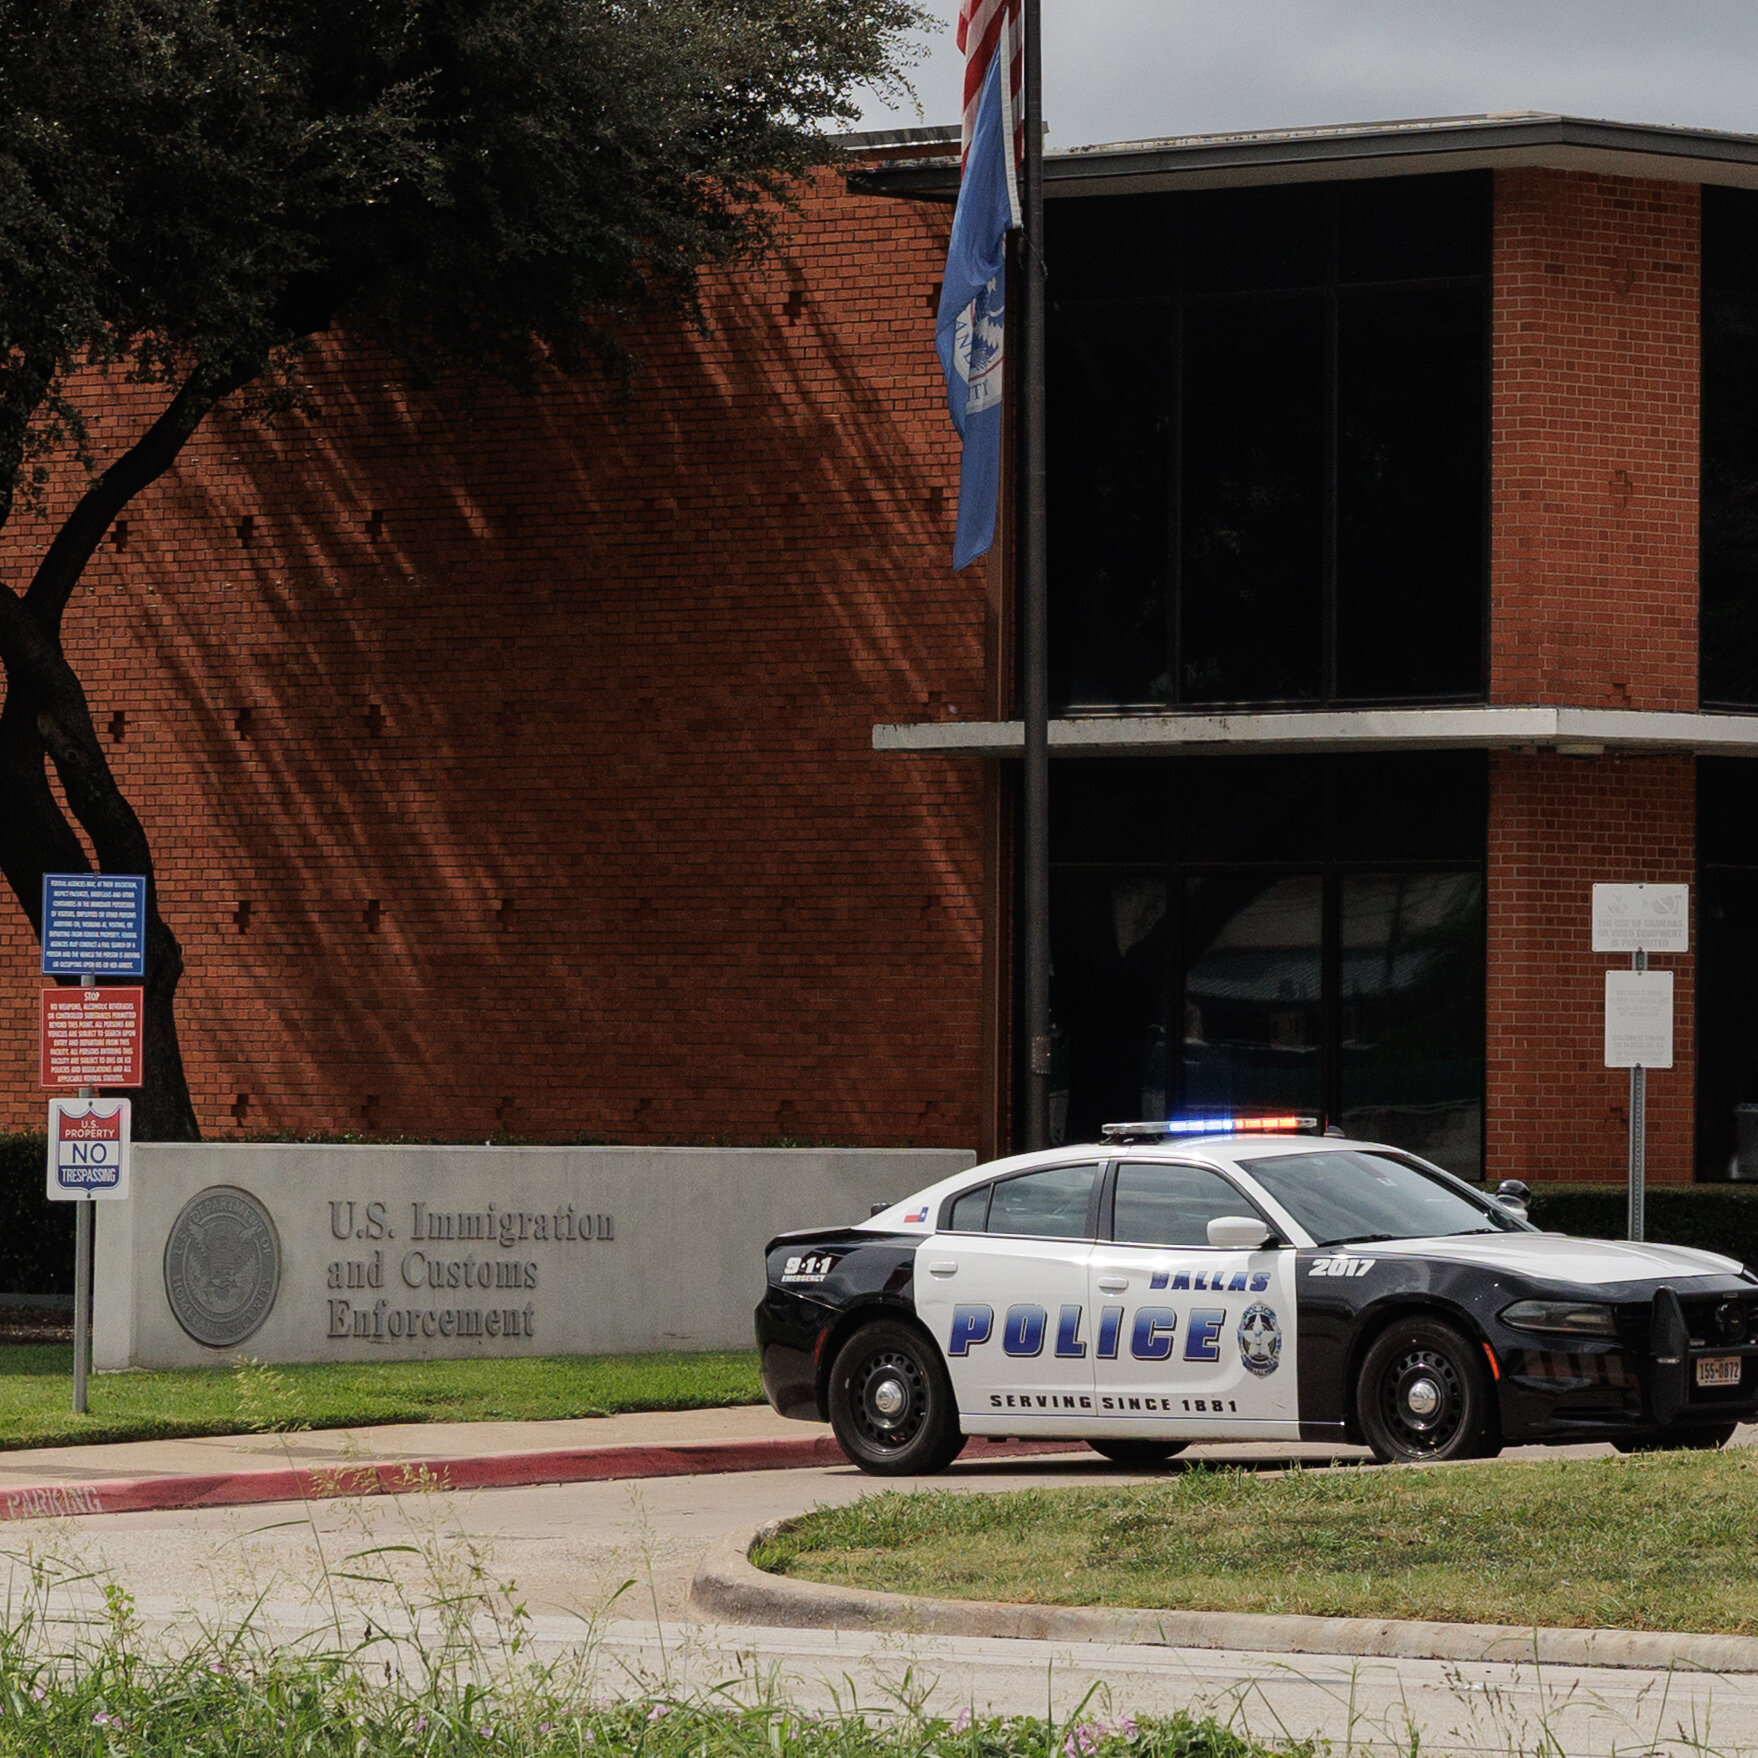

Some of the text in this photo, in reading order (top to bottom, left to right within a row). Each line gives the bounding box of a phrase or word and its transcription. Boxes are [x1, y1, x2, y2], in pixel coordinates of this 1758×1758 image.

[65, 1129, 115, 1138] PROPERTY
[81, 1120, 99, 1128] U.S.
[72, 1143, 107, 1164] NO
[62, 1168, 116, 1183] TRESPASSING
[328, 1200, 615, 1248] U.S. Immigration
[327, 1250, 538, 1289] and Customs
[1308, 1258, 1376, 1277] 2017
[1149, 1271, 1272, 1292] DALLAS
[328, 1298, 535, 1338] Enforcement
[947, 1303, 1227, 1362] POLICE
[990, 1394, 1239, 1413] SERVING SINCE 1881
[6, 1485, 103, 1519] PARKING
